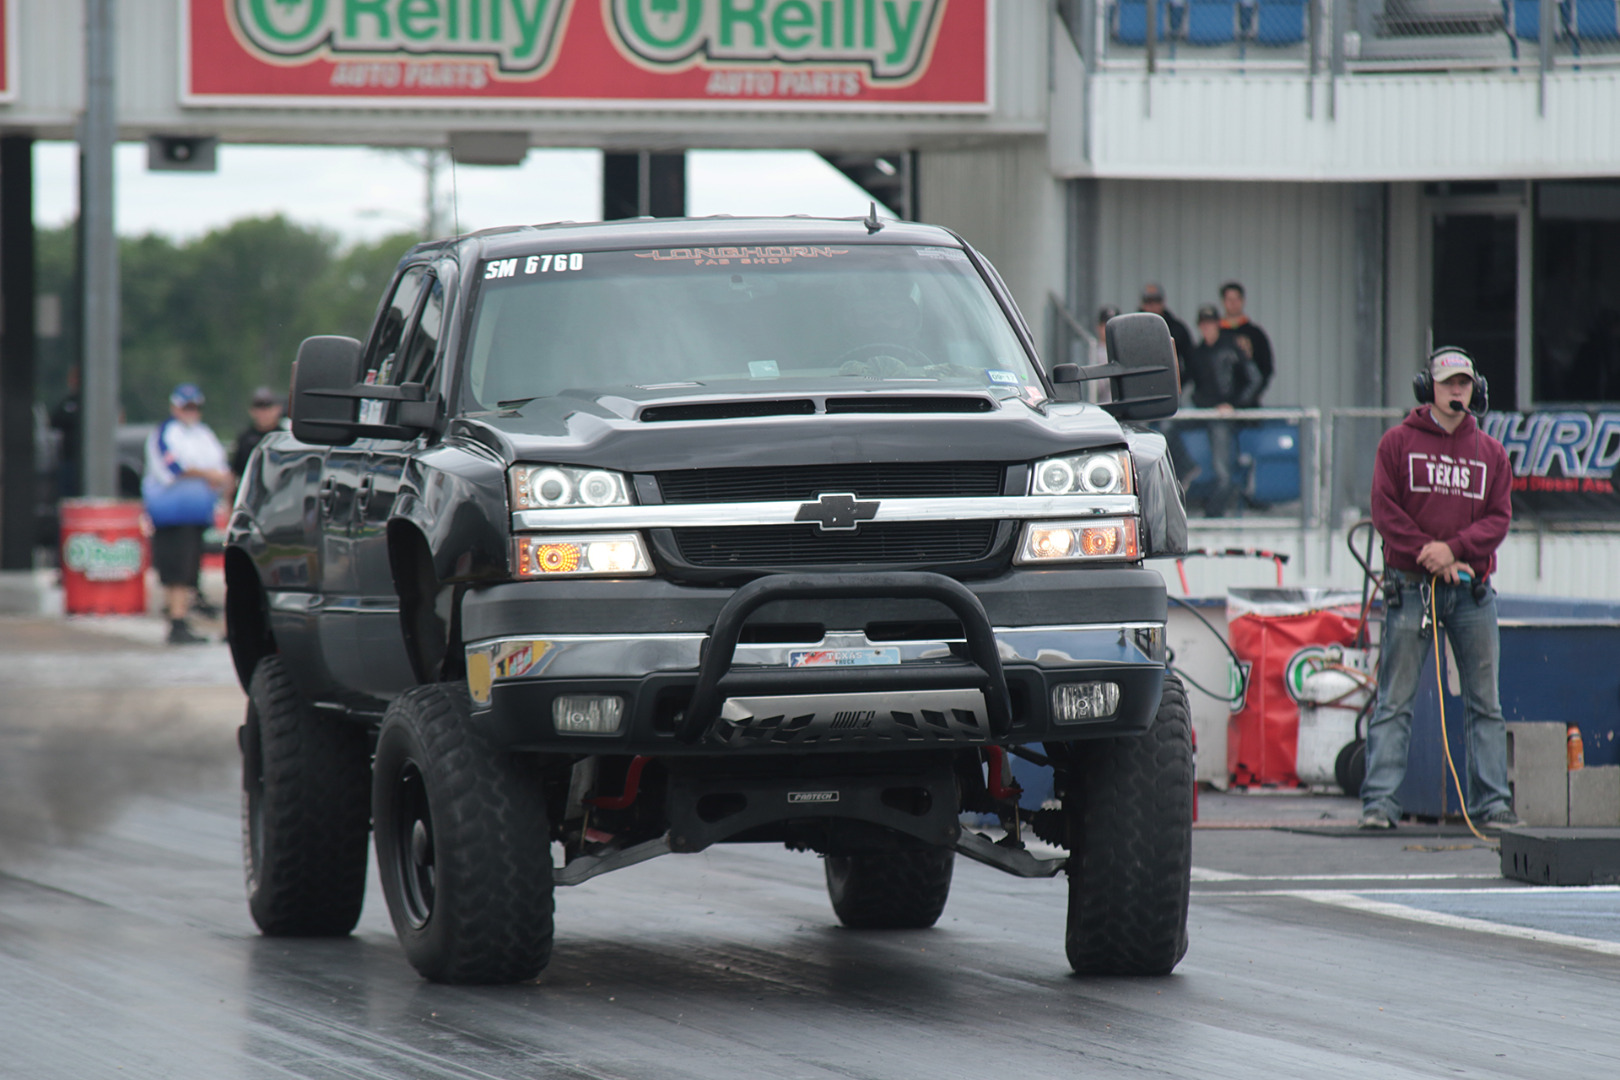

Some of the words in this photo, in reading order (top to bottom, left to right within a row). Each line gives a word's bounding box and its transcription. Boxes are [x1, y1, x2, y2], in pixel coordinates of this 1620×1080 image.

[625, 0, 924, 65] OReilly
[330, 63, 400, 87] AUTO
[404, 64, 488, 89] PARTS
[706, 71, 775, 96] AUTO
[779, 71, 861, 97] PARTS
[484, 258, 518, 279] SM
[524, 253, 583, 274] 6760
[651, 246, 833, 261] LONGHORN
[694, 258, 730, 266] FAB
[740, 257, 793, 265] SHOP
[1426, 462, 1470, 489] TEXAS
[826, 651, 863, 660] TEXAS
